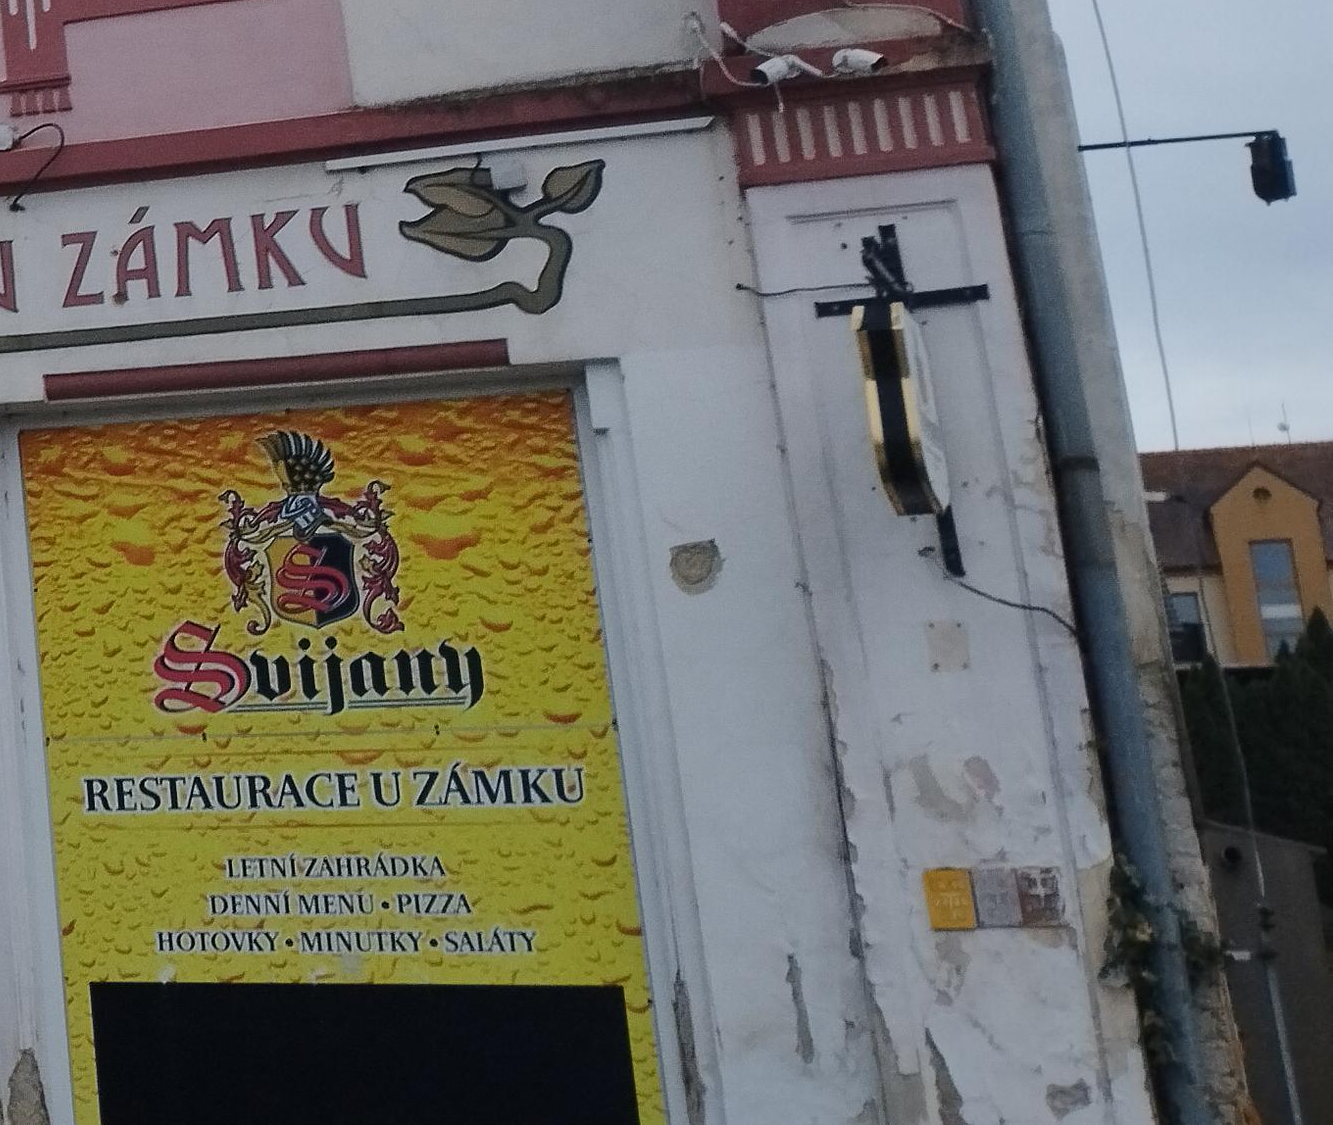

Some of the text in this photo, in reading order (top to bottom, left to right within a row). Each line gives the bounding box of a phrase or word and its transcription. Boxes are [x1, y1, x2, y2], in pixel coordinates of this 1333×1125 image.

[61, 205, 368, 308] ZÁMKU
[153, 619, 485, 715] Svijany
[84, 762, 586, 813] RESTAURACE U ZÁMKU
[225, 851, 446, 879] LETNÍ ZAHRÁDKA
[209, 891, 290, 915] DENNÍ
[396, 894, 472, 915] PIZZA
[157, 928, 537, 953] HOTOVKY MINUTKY SALÁTY
